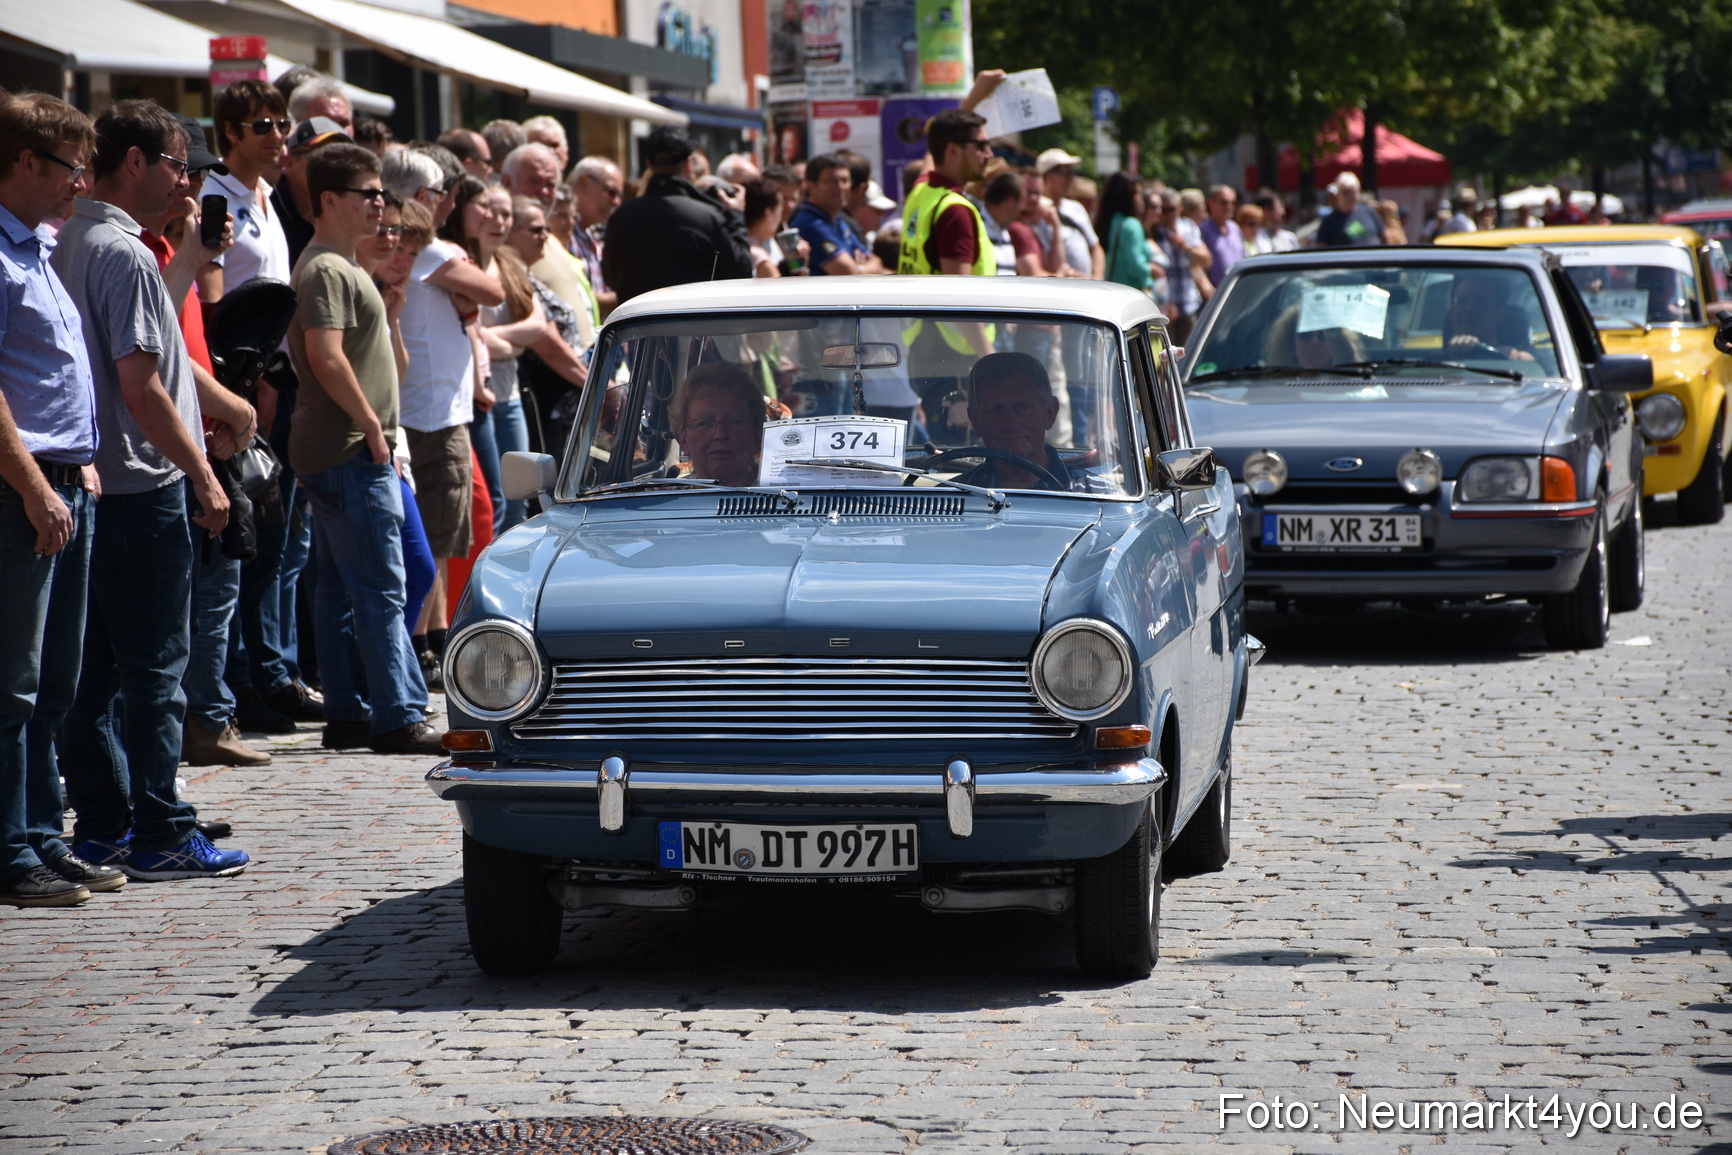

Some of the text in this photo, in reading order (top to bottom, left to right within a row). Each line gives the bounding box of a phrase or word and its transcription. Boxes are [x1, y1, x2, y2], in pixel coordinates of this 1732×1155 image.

[1100, 89, 1115, 116] P
[237, 207, 261, 239] 3
[830, 431, 879, 450] 374
[1279, 517, 1400, 542] NM XR 31
[632, 637, 939, 650] OPEL
[666, 849, 676, 860] D
[683, 827, 731, 866] NM
[760, 830, 808, 868] DT
[682, 872, 695, 880] Kfz
[702, 873, 737, 882] Tischner
[747, 876, 817, 884] Trautmannshofen
